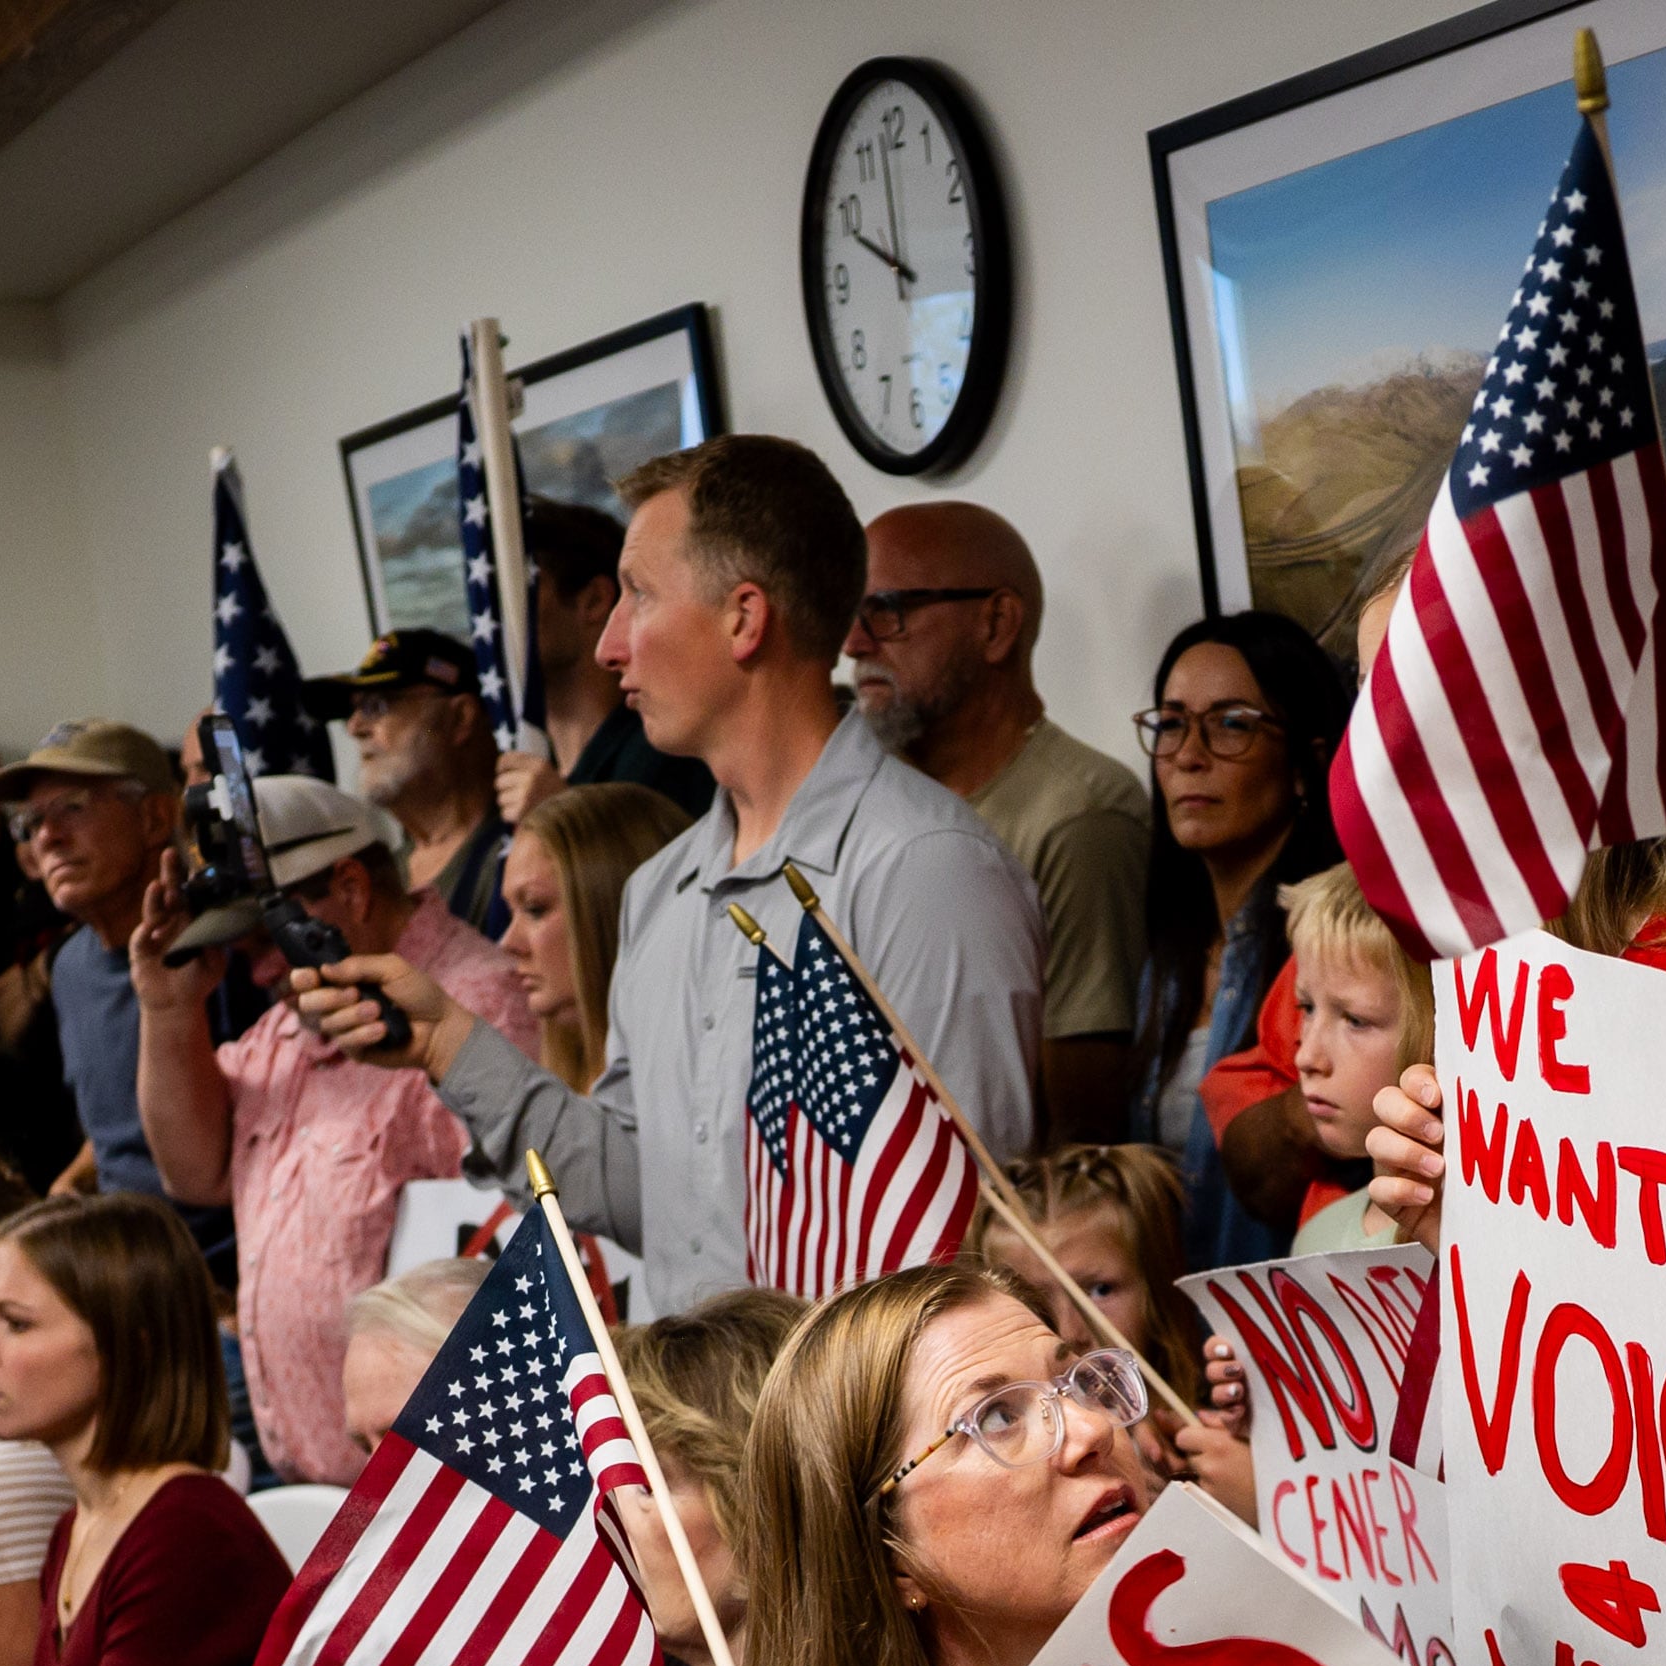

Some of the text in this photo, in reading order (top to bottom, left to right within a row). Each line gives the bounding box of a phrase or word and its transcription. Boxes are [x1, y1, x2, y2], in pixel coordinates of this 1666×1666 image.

[855, 121, 933, 184] 11 1
[881, 105, 906, 150] 12
[838, 159, 963, 238] 10 2
[834, 263, 850, 305] 9
[851, 329, 868, 371] 8
[879, 363, 956, 430] 7 6 5
[1453, 946, 1592, 1096] WE
[1206, 1265, 1379, 1463] NO
